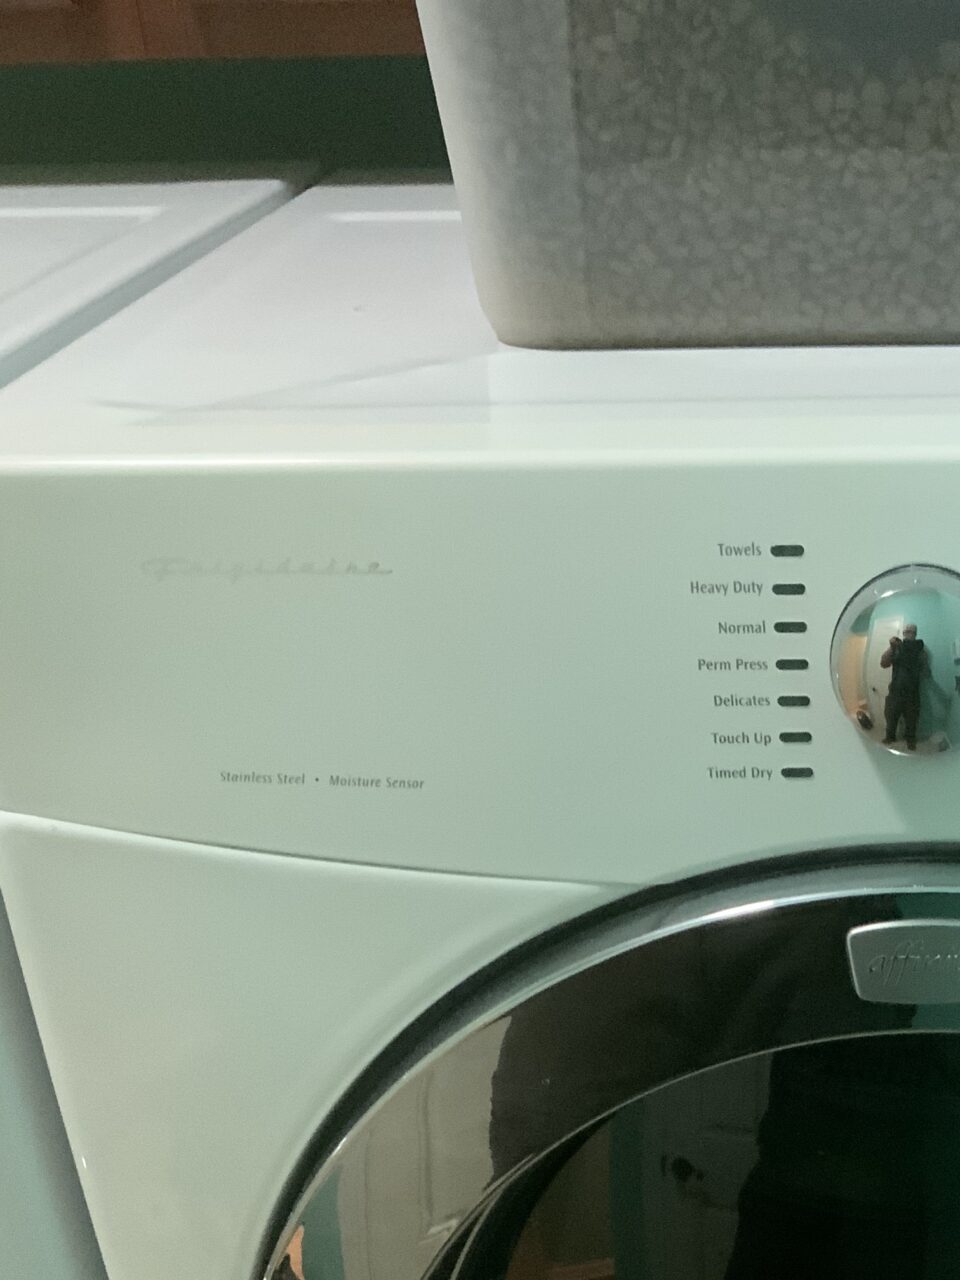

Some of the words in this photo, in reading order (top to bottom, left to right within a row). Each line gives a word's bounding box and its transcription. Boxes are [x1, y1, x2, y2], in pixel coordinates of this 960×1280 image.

[717, 543, 762, 557] Towels
[690, 581, 729, 595] Heavy
[733, 581, 763, 596] Duty
[718, 620, 766, 634] Normal
[697, 658, 731, 671] Perm
[735, 658, 768, 671] Press
[713, 695, 771, 707] Delicates
[711, 732, 750, 744] Touch
[754, 732, 772, 747] Up
[220, 771, 273, 784] Stainless
[277, 772, 306, 785] Steel
[329, 774, 382, 788] Moisture
[386, 776, 425, 789] Sensor
[707, 766, 746, 778] Timed
[751, 767, 773, 781] Dry
